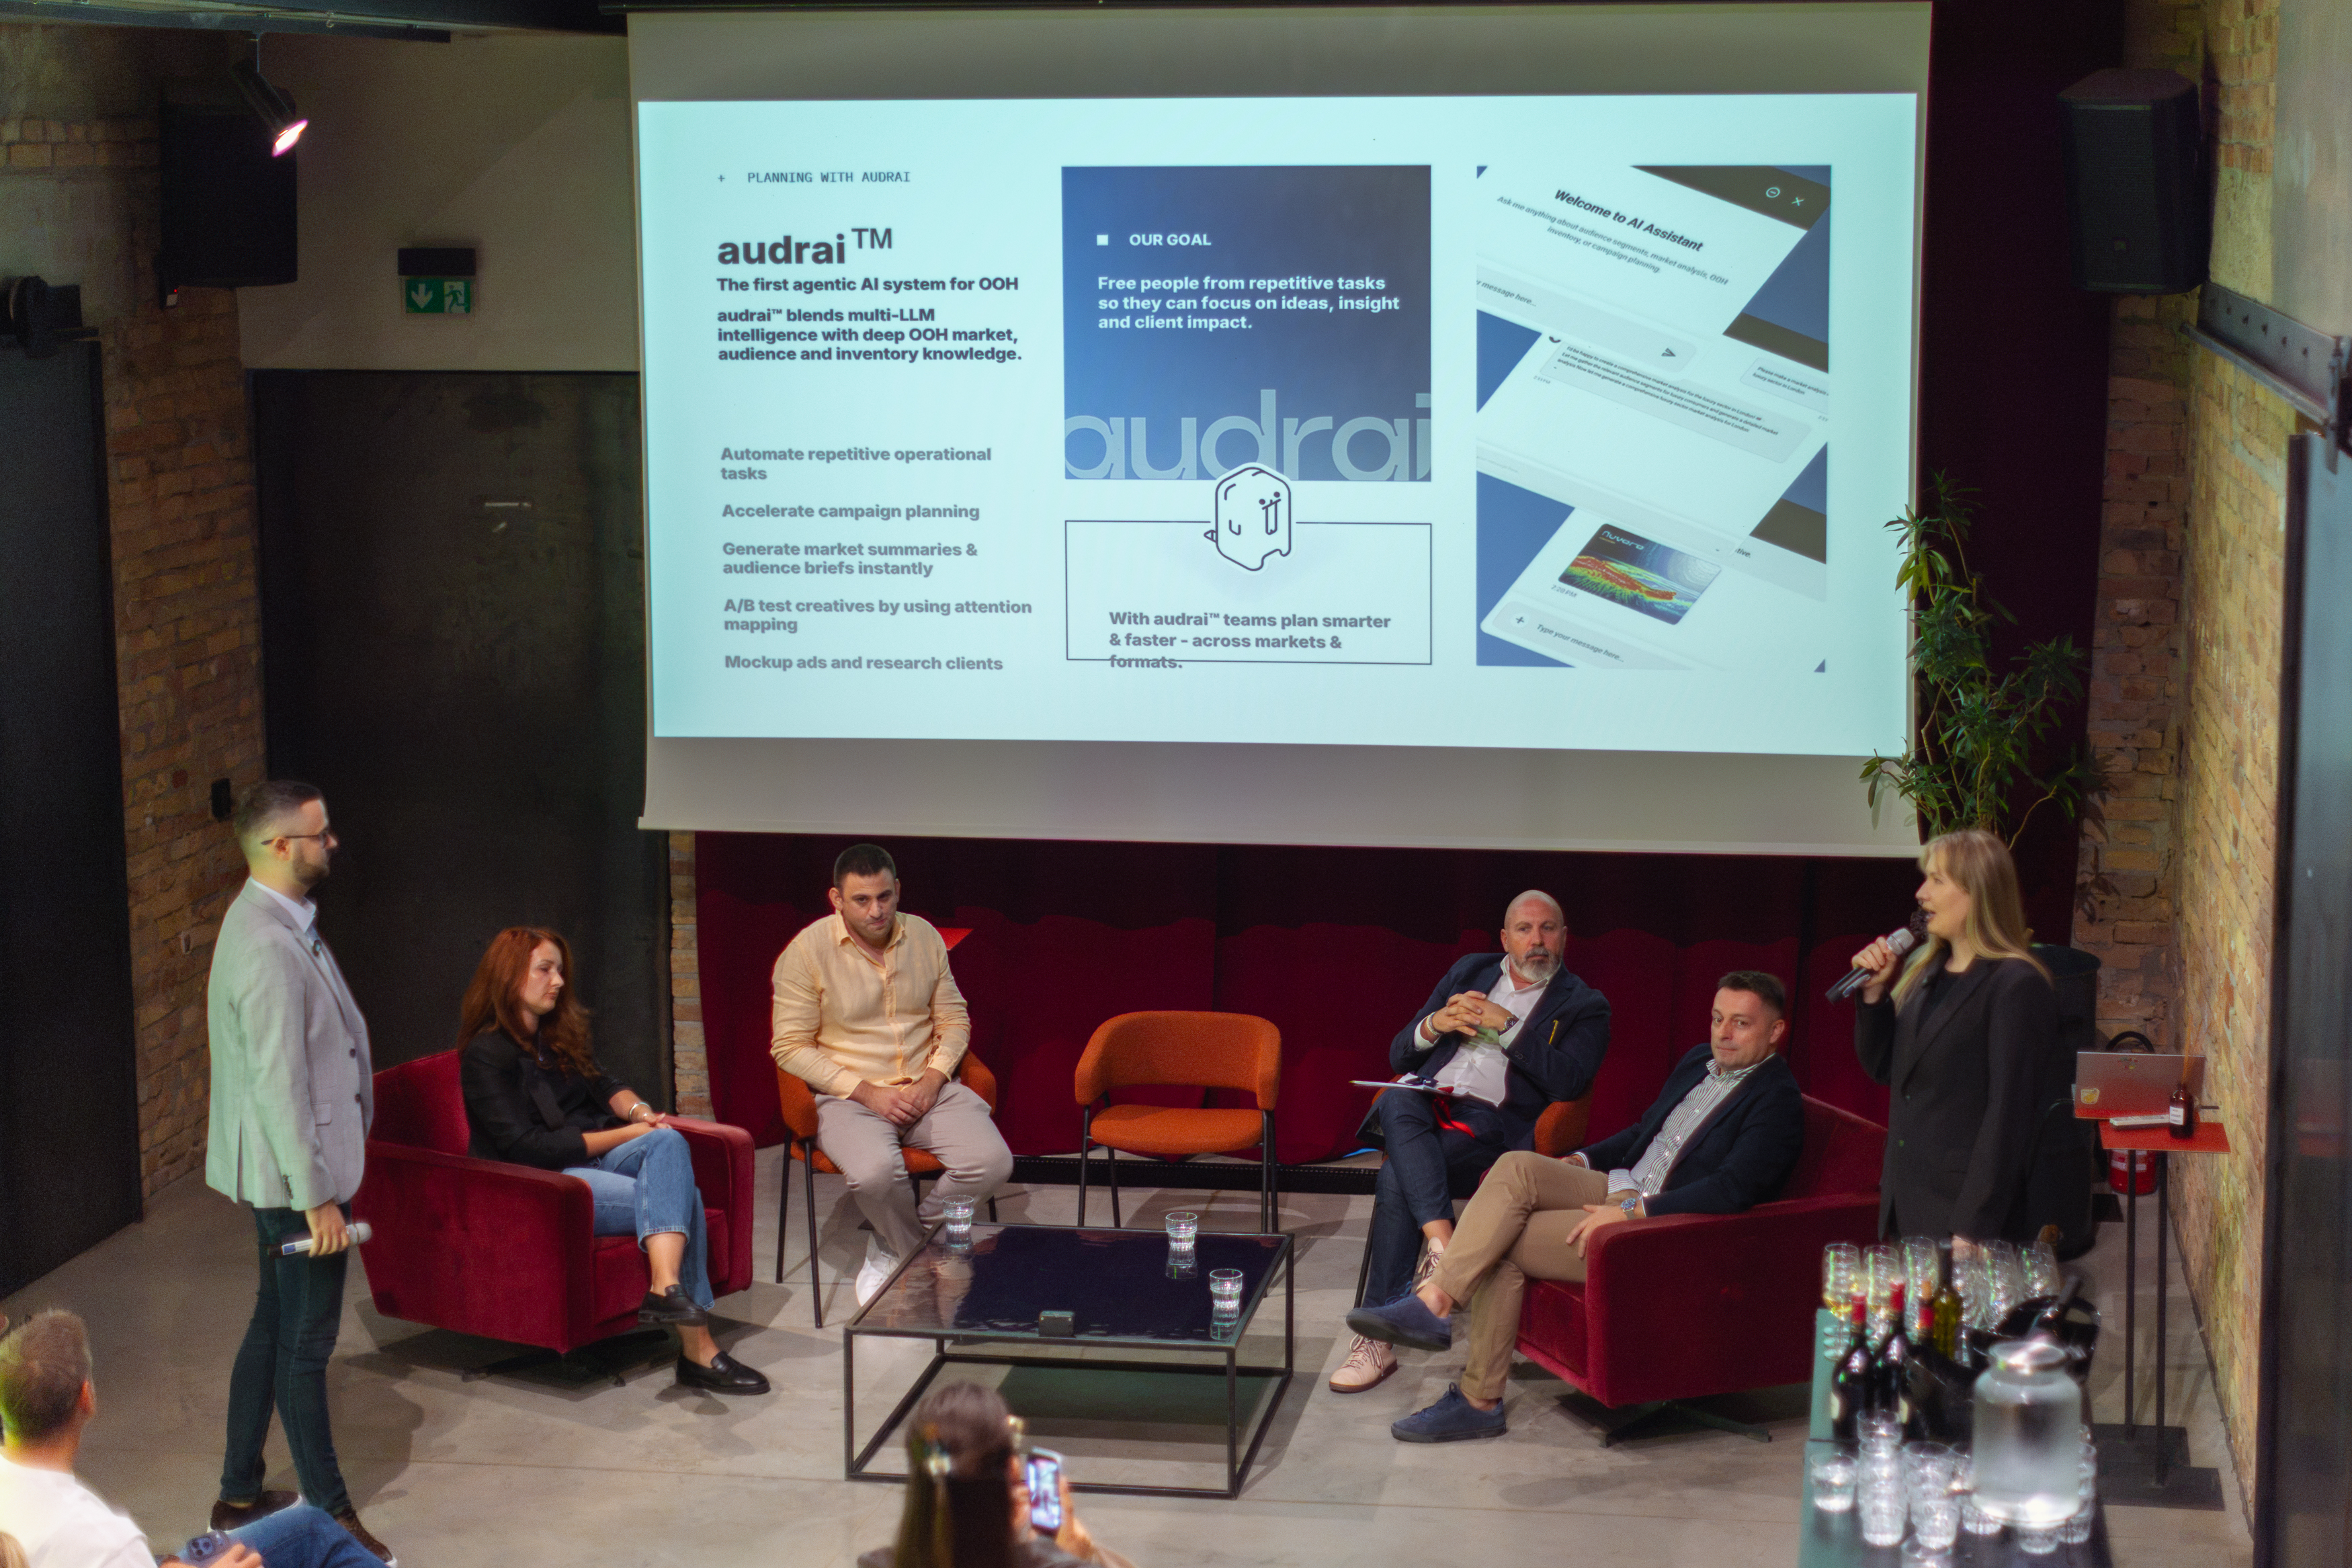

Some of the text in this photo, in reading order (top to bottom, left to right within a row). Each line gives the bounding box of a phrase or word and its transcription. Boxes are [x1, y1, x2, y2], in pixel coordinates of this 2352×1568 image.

[748, 171, 910, 183] PLANNING WITH AUDRAI
[1554, 189, 1703, 251] Welcome to AI Assistant
[1129, 234, 1212, 246] OUR GOAL
[1497, 196, 1512, 205] Ask
[1512, 202, 1525, 210] me
[1525, 207, 1556, 223] anything
[1556, 219, 1579, 230] about
[1578, 227, 1612, 242] audience
[1650, 253, 1677, 266] market
[1677, 263, 1707, 279] analysis,
[1709, 274, 1728, 285] OOH
[1547, 226, 1581, 244] inventory,
[1591, 243, 1628, 260] campaign
[716, 277, 1018, 294] The first agentic AI system for OOH
[1098, 275, 1386, 293] Free people from repetitive tasks
[1481, 282, 1514, 298] message
[1099, 296, 1400, 313] so they can focus on ideas, insight
[786, 308, 844, 322] blends
[848, 308, 935, 322] multi-LLM
[1098, 314, 1252, 332] and client impact.
[718, 328, 1017, 345] intelligence with deep OOH market,
[718, 347, 1022, 363] audience and inventory knowledge.
[1064, 389, 1431, 480] audrai
[720, 447, 991, 464] Automate repetitive operational
[720, 467, 767, 480] tasks
[722, 504, 980, 521] Accelerate campaign planning
[722, 542, 978, 556] Generate market summaries &
[723, 560, 933, 578] audience briefs instantly
[724, 599, 1032, 616] A/B test creatives by using attention
[724, 617, 798, 634] mapping
[1109, 611, 1150, 625] With
[1223, 613, 1277, 627] teams
[1281, 613, 1318, 630] plan
[1322, 615, 1391, 628] smarter
[1109, 633, 1121, 646] &
[1124, 633, 1177, 646] faster
[1192, 637, 1251, 648] across
[1255, 635, 1326, 648] markets
[1330, 636, 1342, 649] &
[1537, 623, 1554, 634] Type
[1553, 631, 1570, 640] your
[1570, 638, 1603, 653] message
[725, 655, 1003, 672] Mockup ads and research clients
[1109, 654, 1183, 668] formats.
